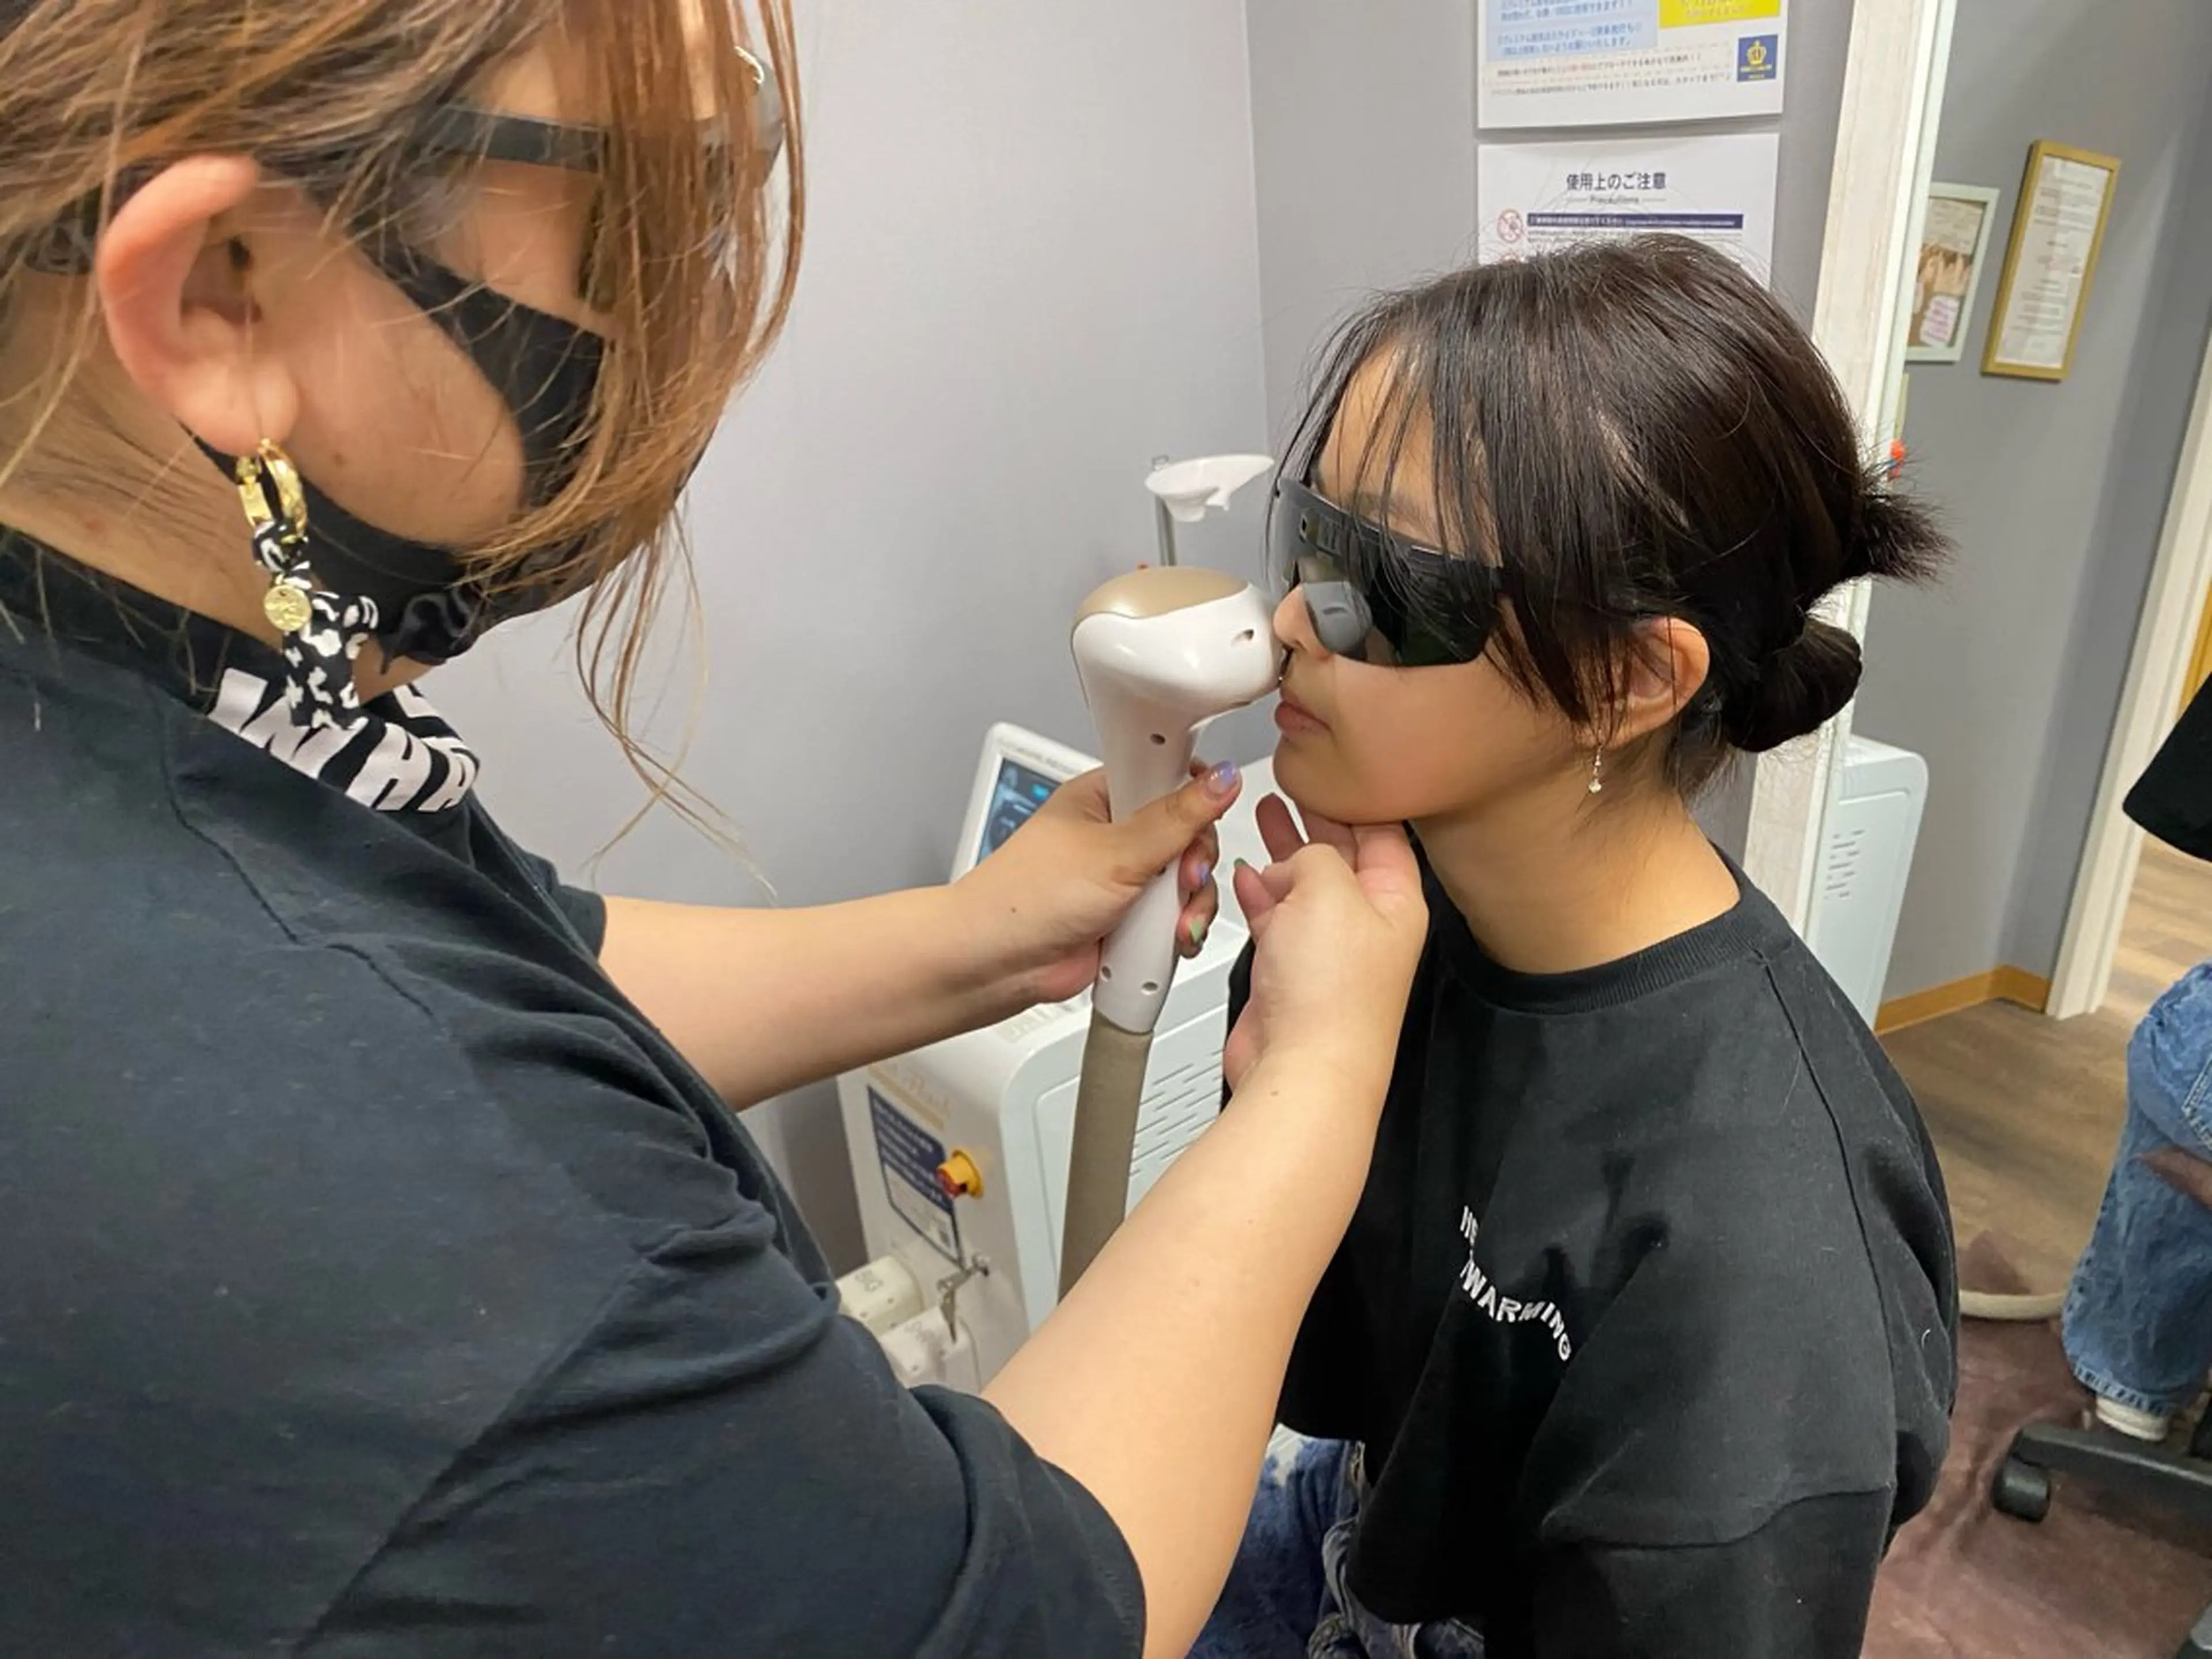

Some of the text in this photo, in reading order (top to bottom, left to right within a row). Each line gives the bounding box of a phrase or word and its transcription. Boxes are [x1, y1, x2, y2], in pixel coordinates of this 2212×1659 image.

[1566, 172, 1665, 191] 使用上のご注意
